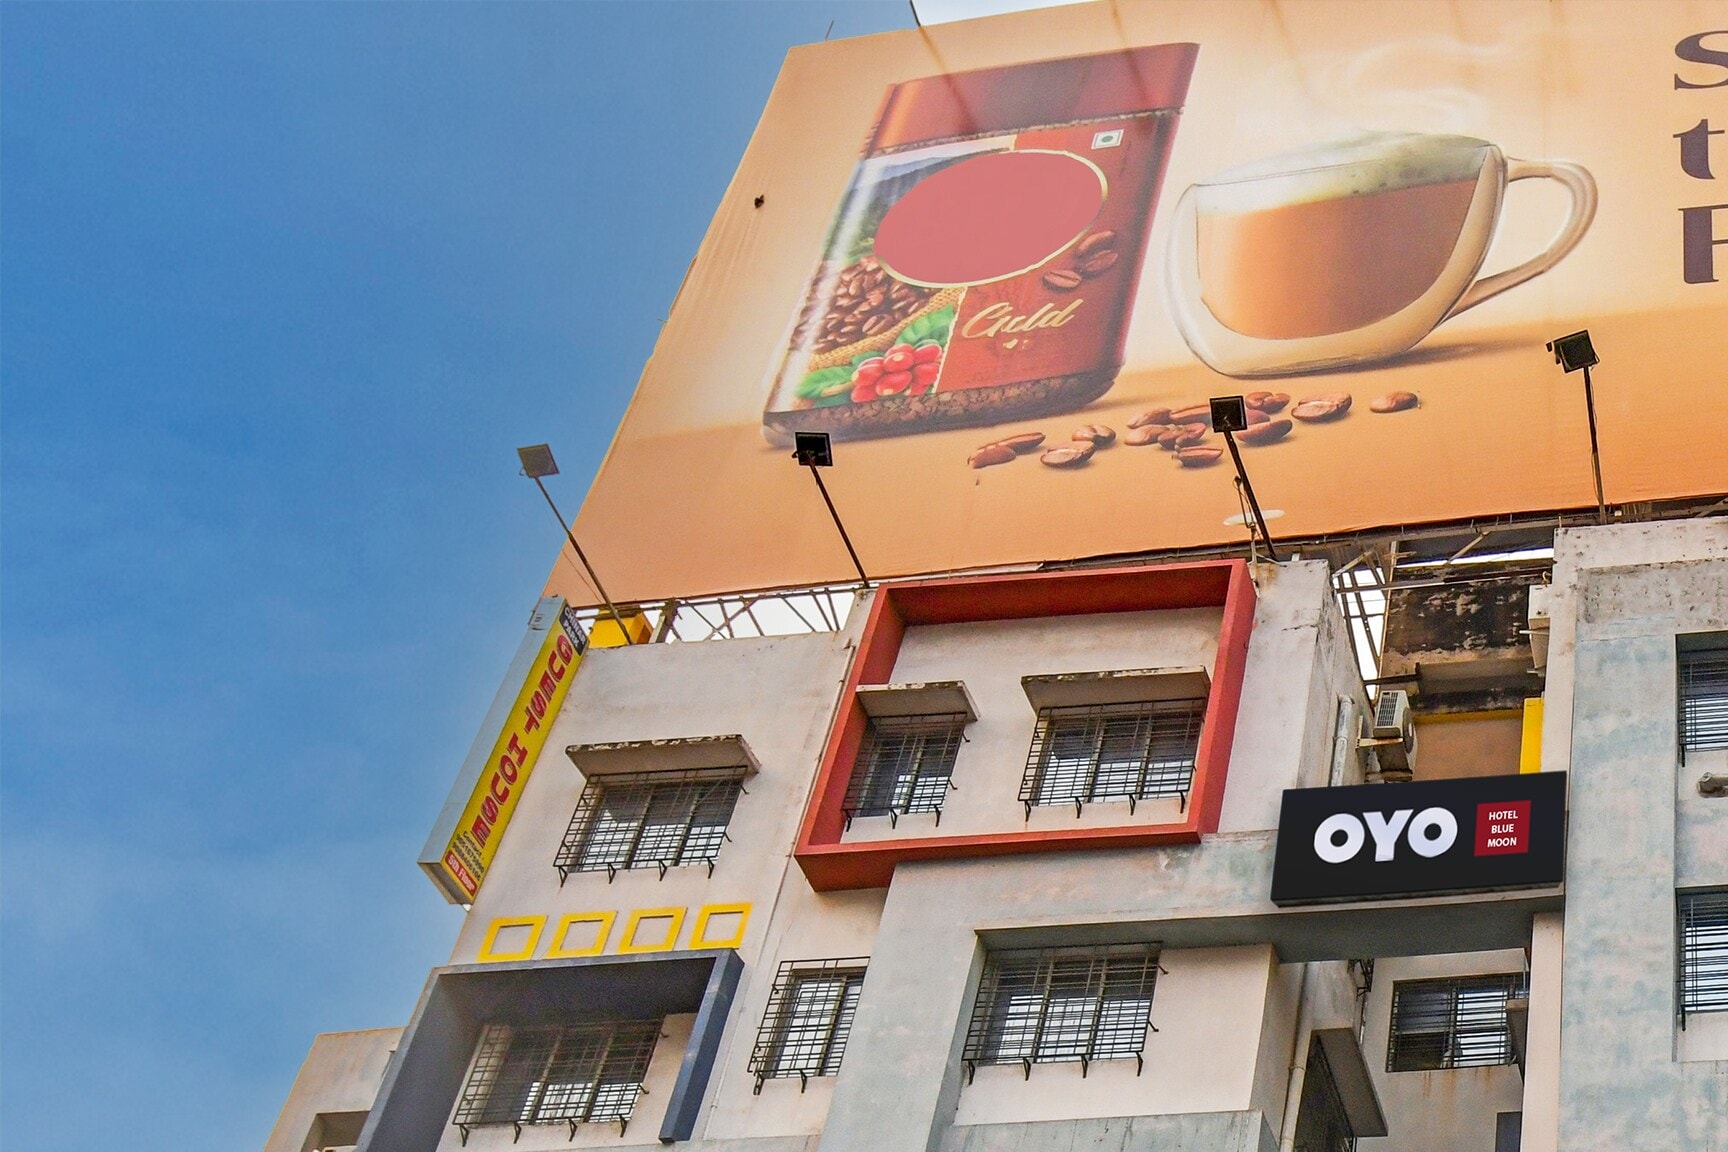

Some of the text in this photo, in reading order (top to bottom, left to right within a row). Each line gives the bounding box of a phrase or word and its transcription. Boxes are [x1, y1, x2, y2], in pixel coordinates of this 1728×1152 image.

[563, 620, 579, 647] PARK
[1488, 810, 1518, 821] HOTEL
[1491, 824, 1514, 833] BLUE
[1314, 807, 1458, 863] OYO
[1487, 837, 1517, 847] MOON
